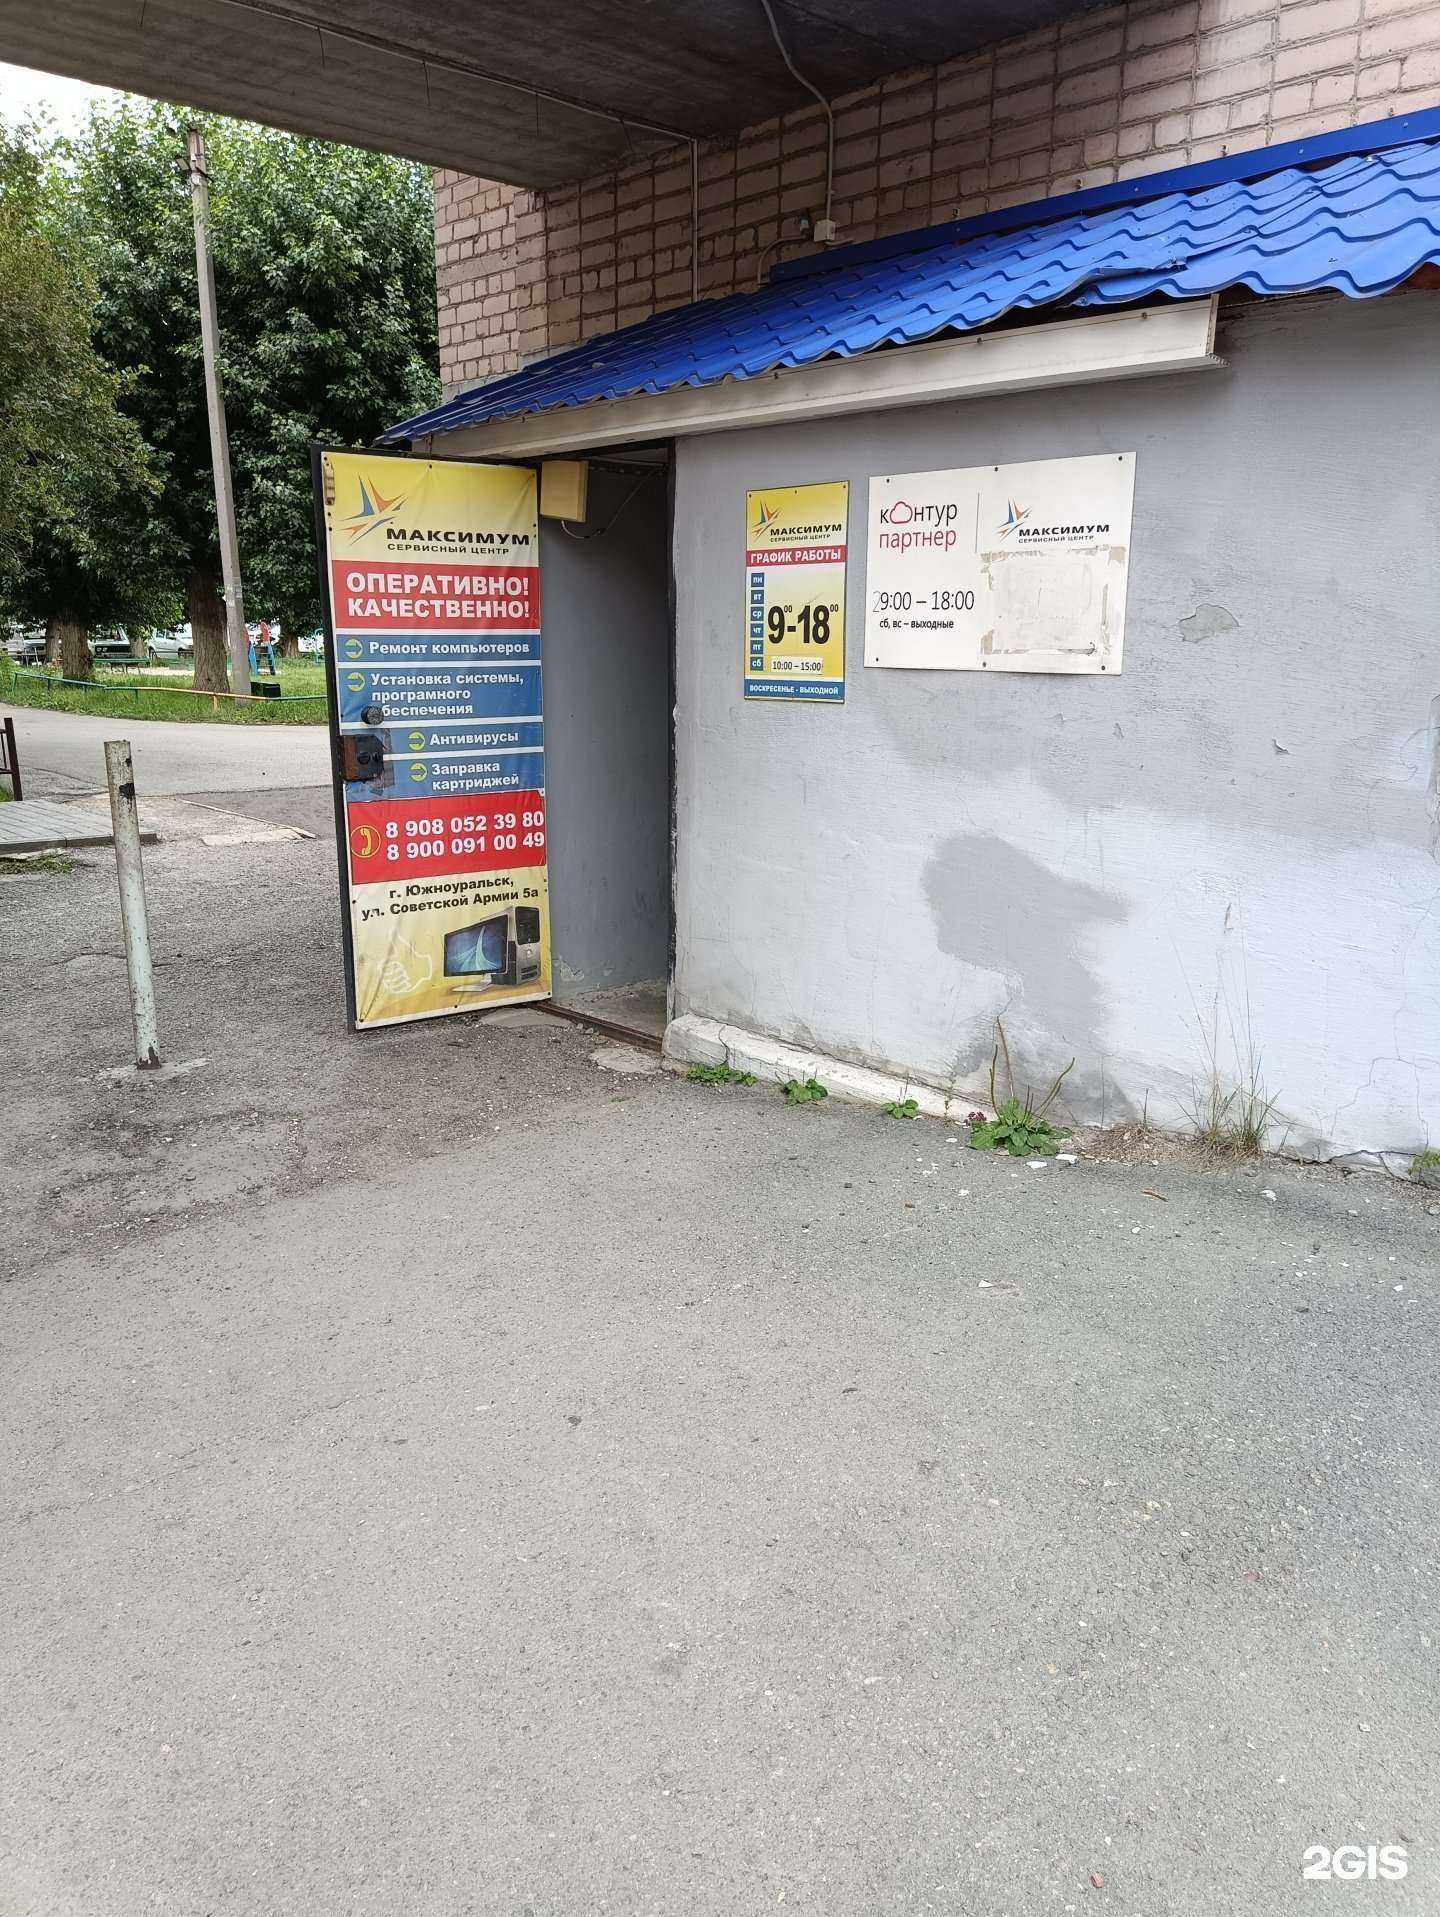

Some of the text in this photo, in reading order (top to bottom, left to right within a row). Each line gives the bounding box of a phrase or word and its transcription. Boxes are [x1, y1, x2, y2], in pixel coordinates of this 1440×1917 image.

[880, 501, 958, 527] контур
[386, 528, 531, 545] МАКСИМУМ
[770, 524, 842, 536] МАКСИМУМ
[1018, 524, 1110, 537] МАКСИМУМ
[770, 533, 831, 543] СЕРВИСНЫЙ ЦЕНТР
[879, 529, 957, 553] партнер
[1018, 534, 1095, 544] СЕРВИСНЫЙ ЦЕНТР
[387, 543, 510, 556] СЕРВИСНЫЙ ЦЕНТР
[750, 548, 841, 564] ГРАФИК РАБОТЫ
[346, 572, 530, 597] ОПЕРАТИВНО!
[752, 576, 763, 584] пн
[753, 593, 762, 601] вт
[931, 590, 975, 610] 18:00
[347, 598, 530, 619] КАЧЕСТВЕННО!
[752, 611, 762, 619] ср
[880, 617, 891, 629] сб,
[893, 620, 902, 628] вс
[911, 620, 955, 630] выходные
[369, 641, 530, 656] Ремонт компьютеров
[752, 659, 762, 667] сб
[772, 661, 793, 670] 10:00
[800, 662, 822, 671] 15:00
[371, 671, 524, 686] Установка системы,
[371, 689, 471, 703] програмного
[749, 684, 795, 693] ВОСКРЕСЕНЬЕ
[799, 686, 839, 695] ВЫХОДНОЙ
[381, 704, 473, 717] беспечения
[429, 732, 519, 746] Антивирусы
[431, 761, 500, 776] Заправка
[432, 774, 519, 792] картриджей
[385, 810, 545, 839] 8 908 052 39 80
[386, 831, 545, 861] 8 900 091 00 49
[389, 876, 514, 899] г. Южноуральск,
[390, 896, 469, 915] Советской
[473, 889, 519, 905] Армии
[522, 887, 539, 899] 5а
